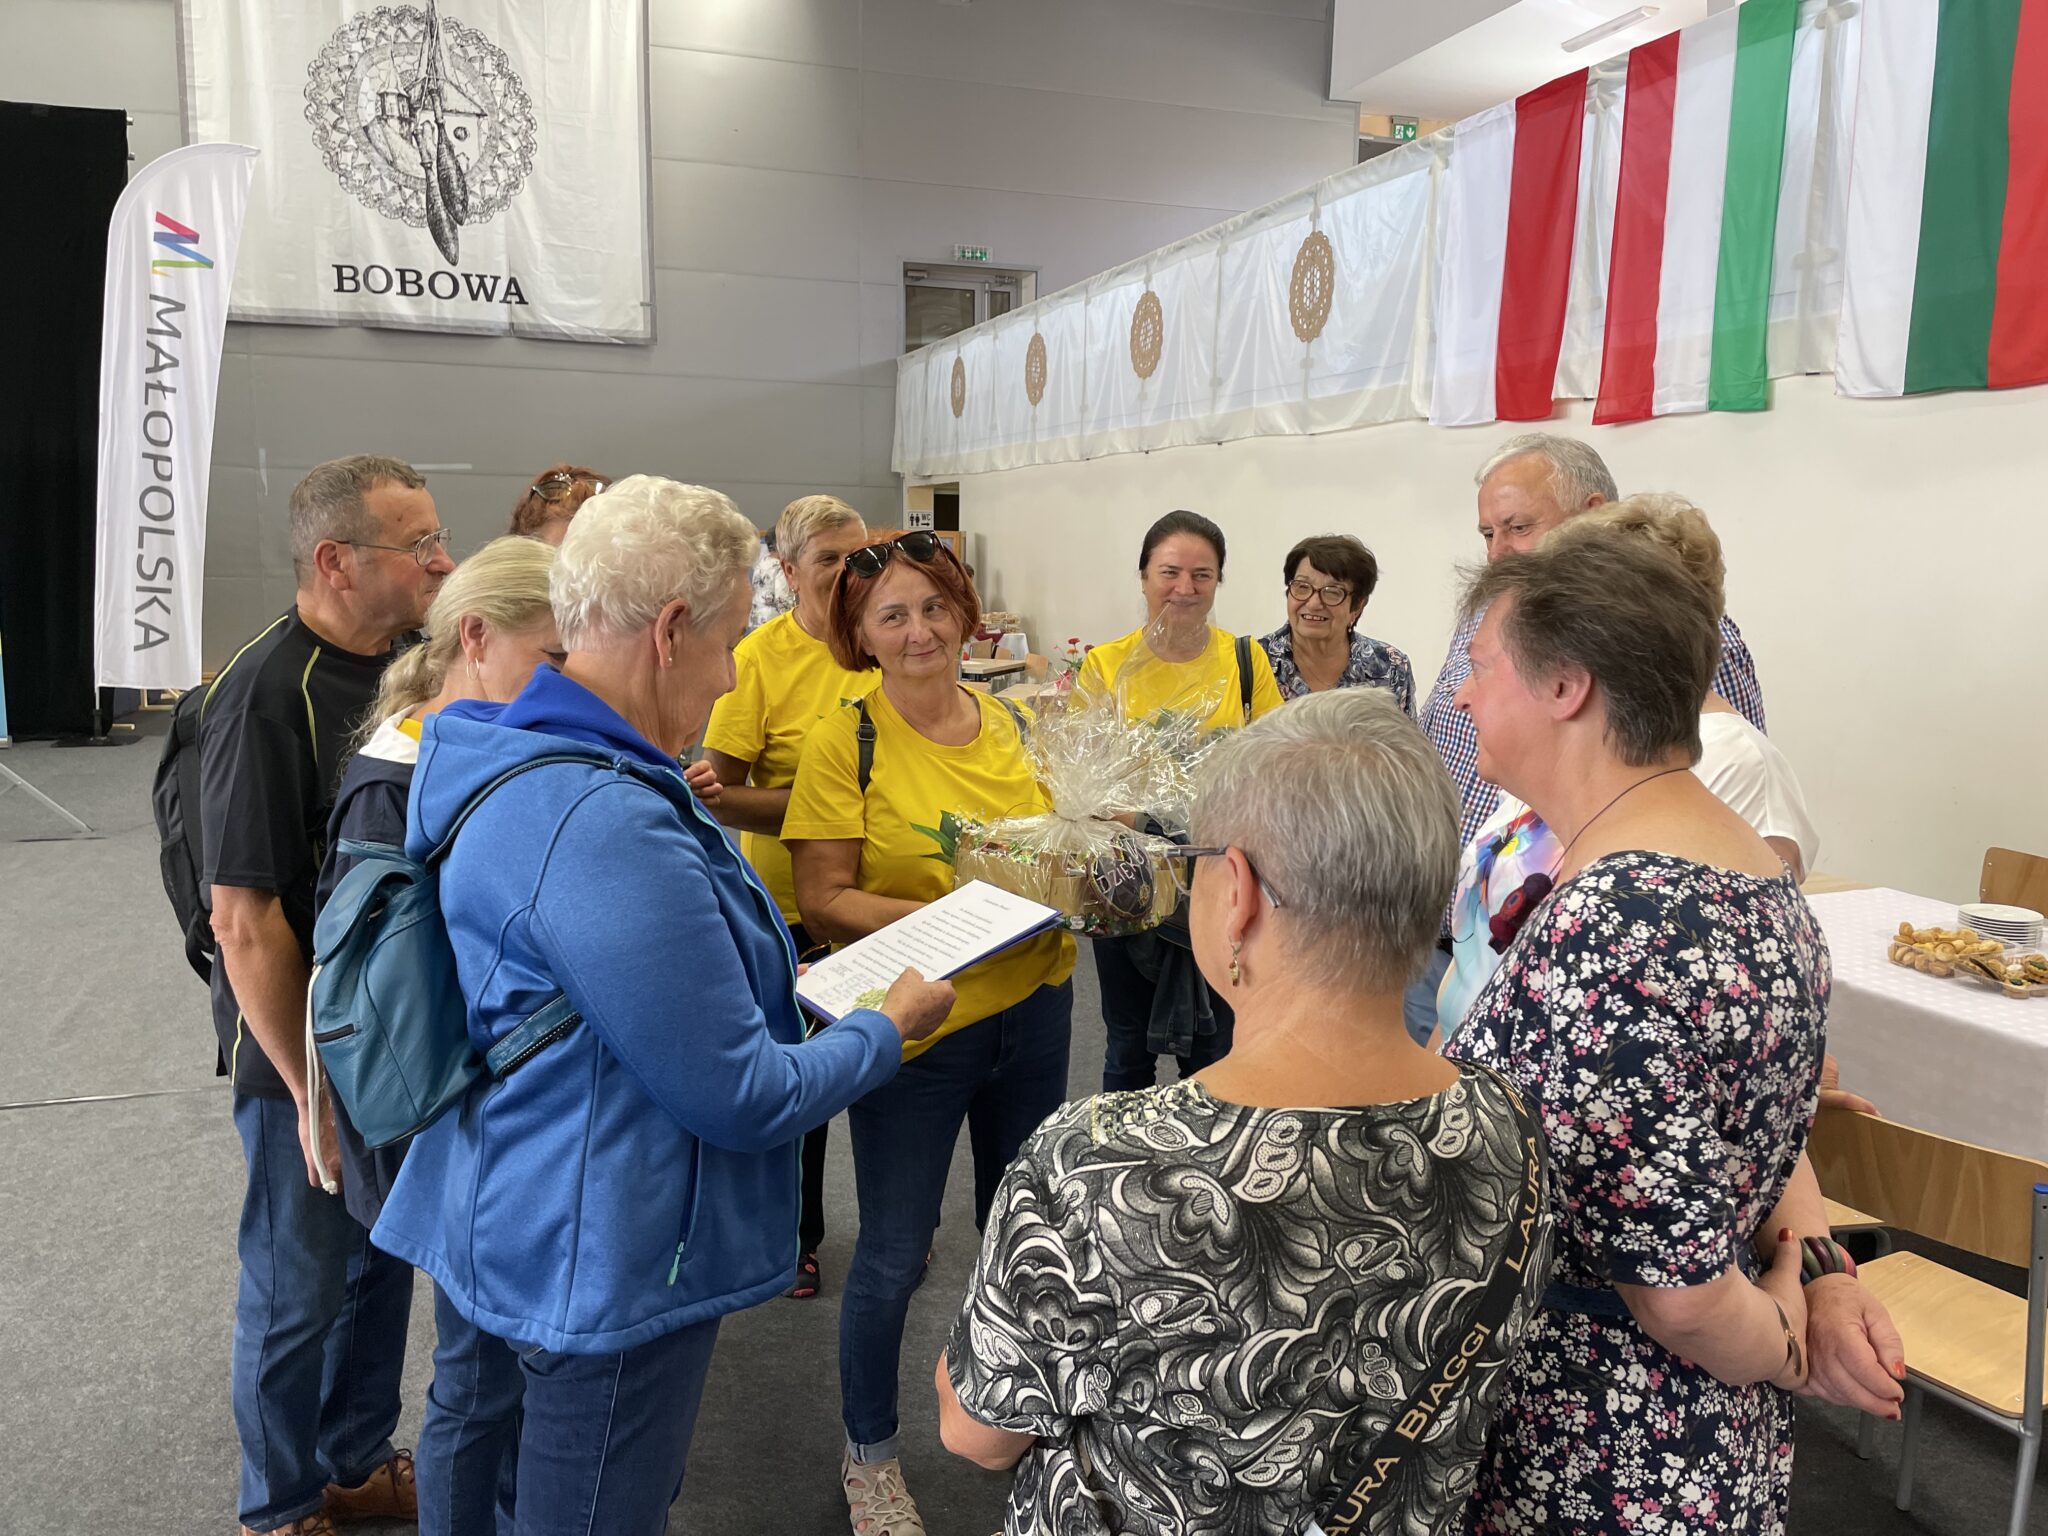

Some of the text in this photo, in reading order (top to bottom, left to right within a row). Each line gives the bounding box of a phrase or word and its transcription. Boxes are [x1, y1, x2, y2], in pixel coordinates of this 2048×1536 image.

[332, 264, 529, 305] BOBOWA
[133, 293, 187, 653] MAŁOPOLSKA
[921, 513, 932, 521] WC
[1394, 1322, 1491, 1441] BIAGGI
[1505, 1136, 1539, 1274] LAURA
